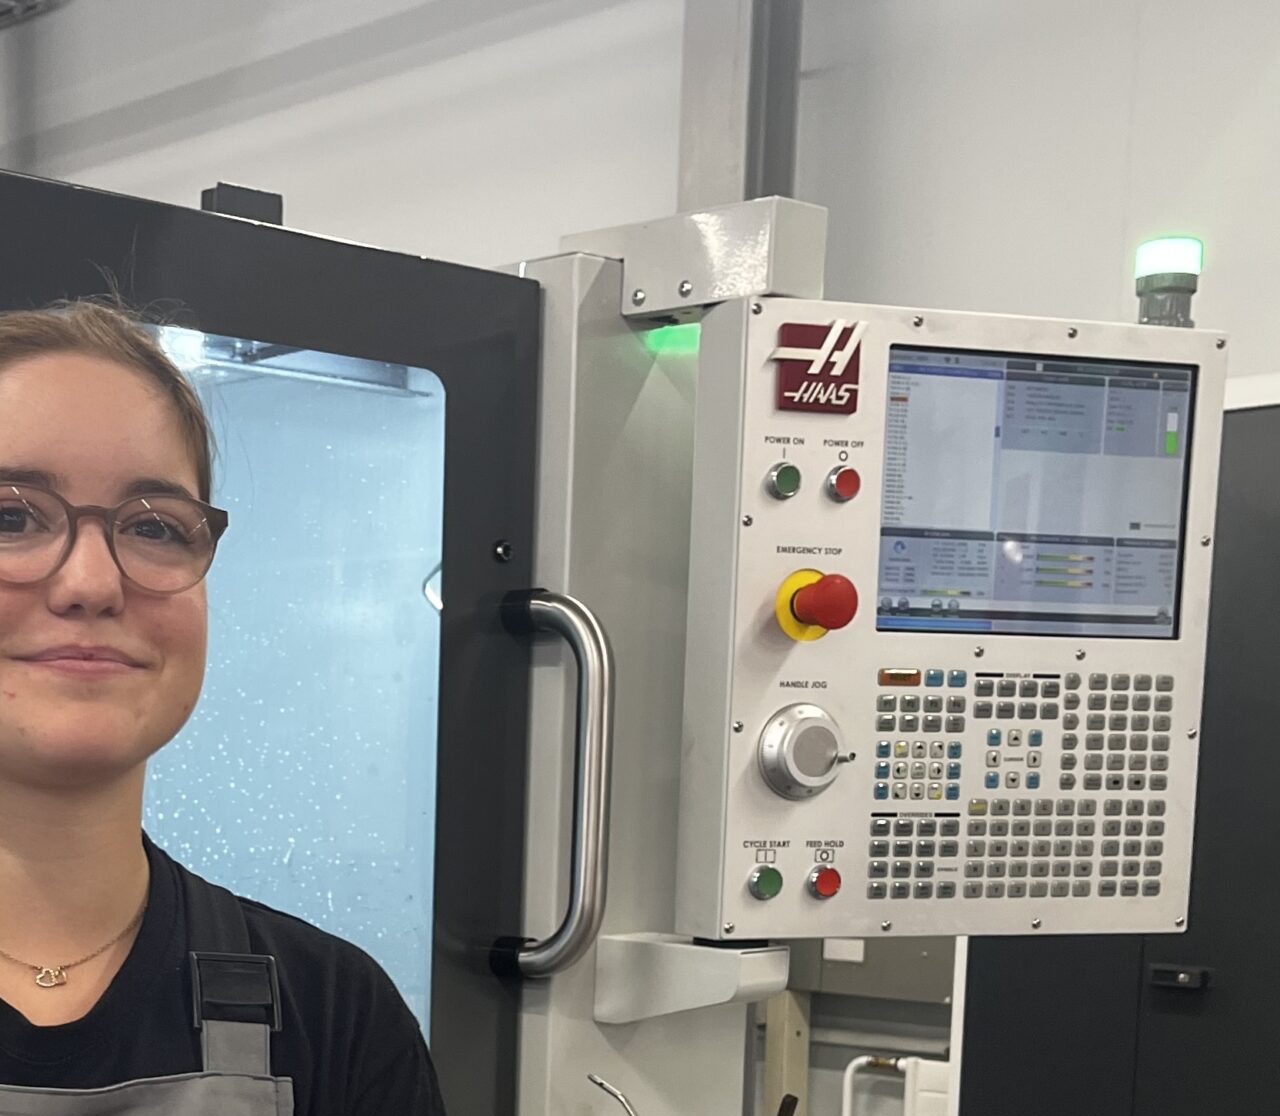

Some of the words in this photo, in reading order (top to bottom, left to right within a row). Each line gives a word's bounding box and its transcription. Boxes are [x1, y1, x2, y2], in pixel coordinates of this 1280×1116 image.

[783, 381, 859, 405] HAAS
[764, 436, 791, 445] POWER
[823, 439, 849, 447] POWER
[776, 546, 822, 555] EMERGENCY
[824, 547, 842, 555] STOP
[811, 681, 827, 689] JOG
[743, 840, 767, 848] CYCLE
[769, 840, 791, 848] START
[805, 840, 823, 848] FEED
[824, 840, 845, 848] HOLD
